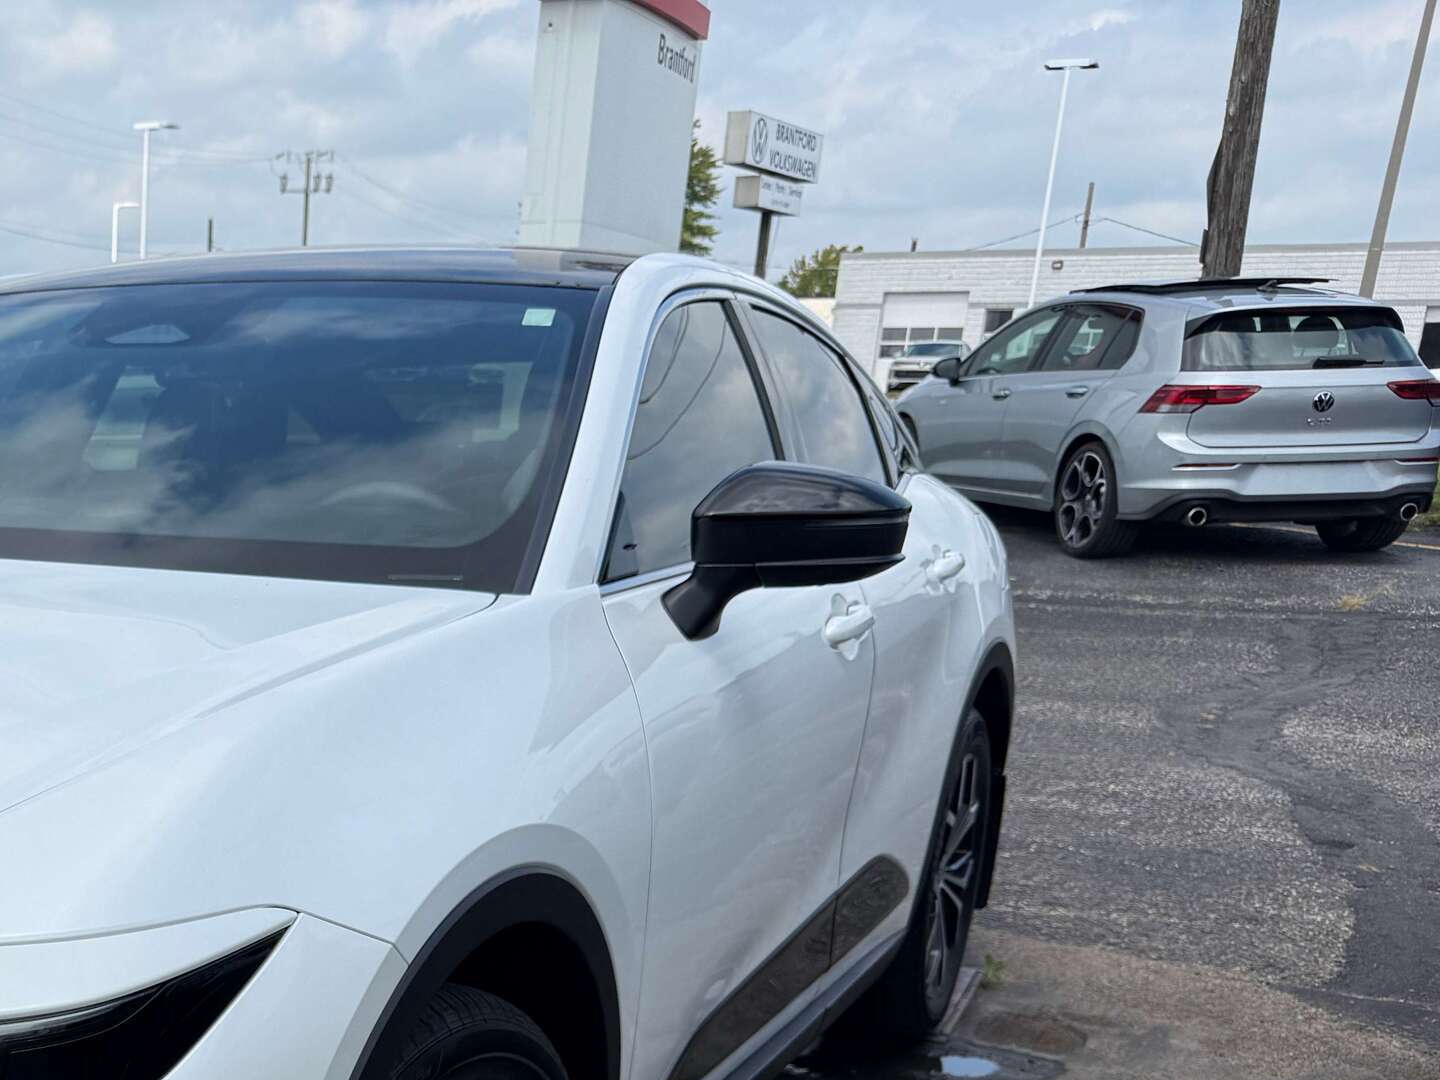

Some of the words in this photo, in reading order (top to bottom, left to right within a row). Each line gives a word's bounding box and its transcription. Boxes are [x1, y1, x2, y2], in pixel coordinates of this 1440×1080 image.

[657, 33, 697, 83] Brantford
[775, 123, 817, 152] BRANTFORD
[769, 149, 816, 179] VOLKSWAGEN
